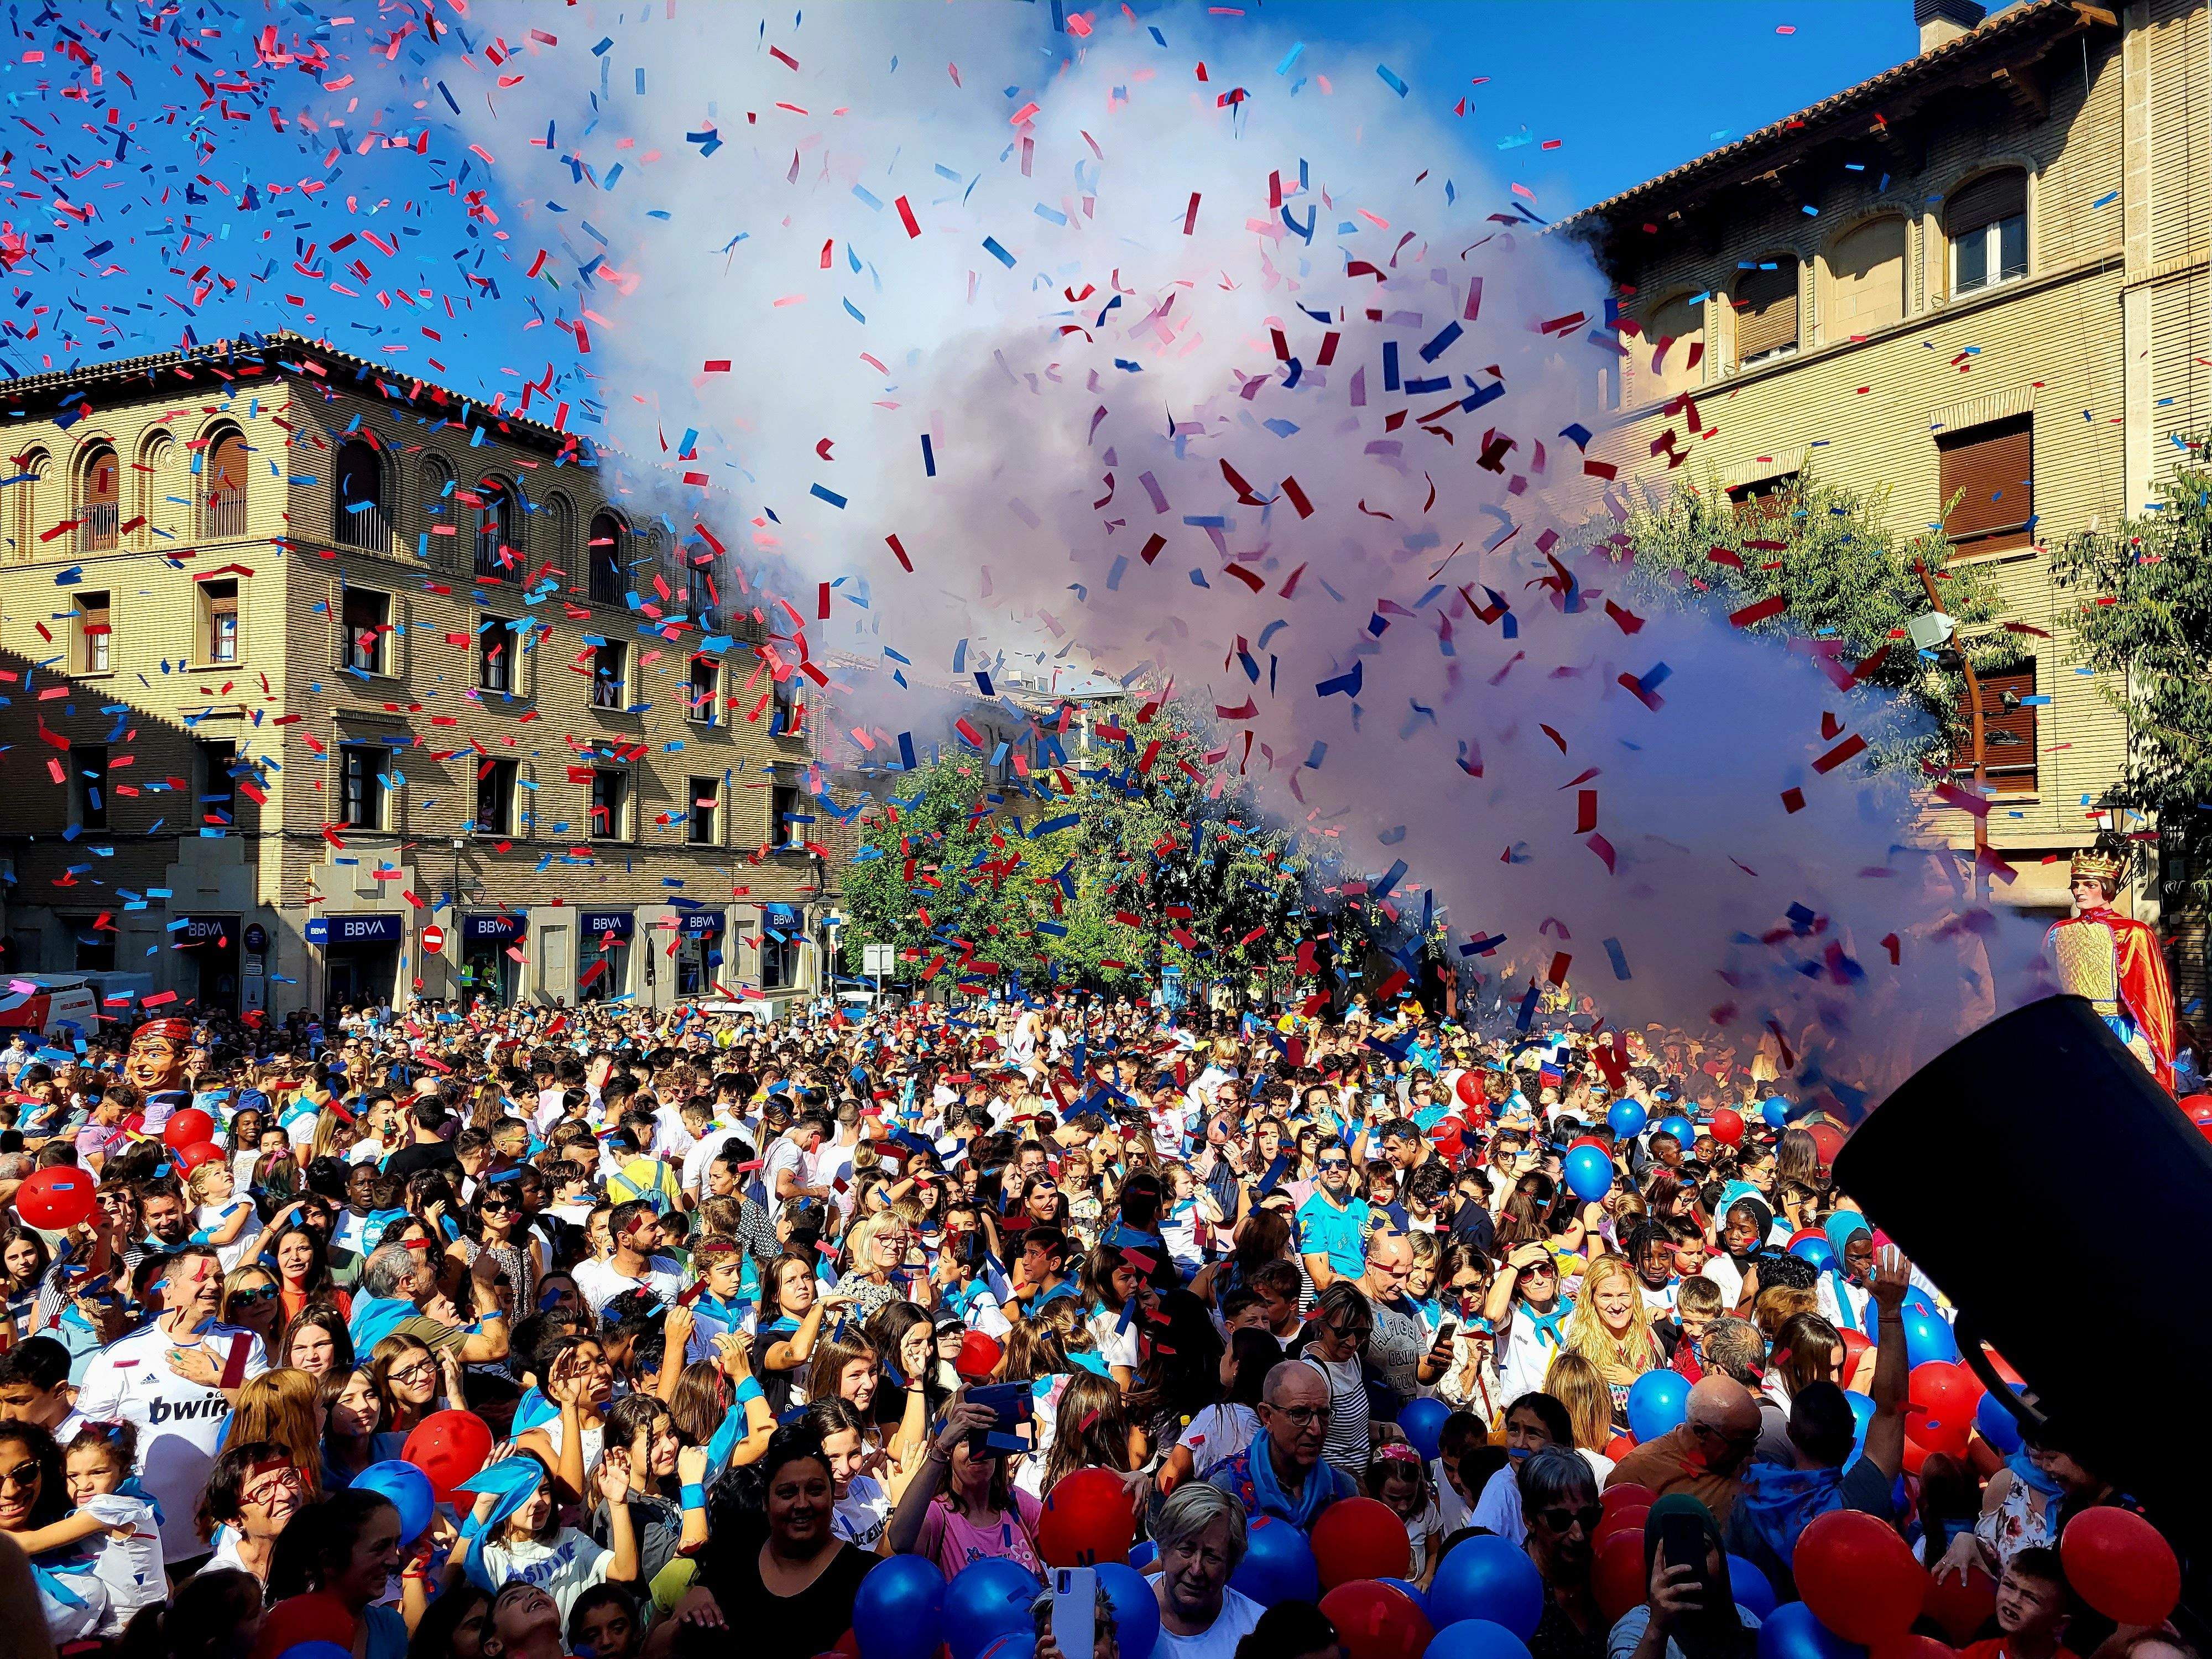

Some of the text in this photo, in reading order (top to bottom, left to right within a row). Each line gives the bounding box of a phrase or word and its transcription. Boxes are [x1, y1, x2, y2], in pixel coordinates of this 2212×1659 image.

[593, 916, 621, 930] BBVA
[691, 915, 714, 927] BBVA
[774, 915, 795, 925] BBVA
[189, 921, 223, 936] BBVA
[345, 920, 385, 936] BBVA
[1370, 1318, 1417, 1352] HILFIGE
[149, 1392, 229, 1425] bwin
